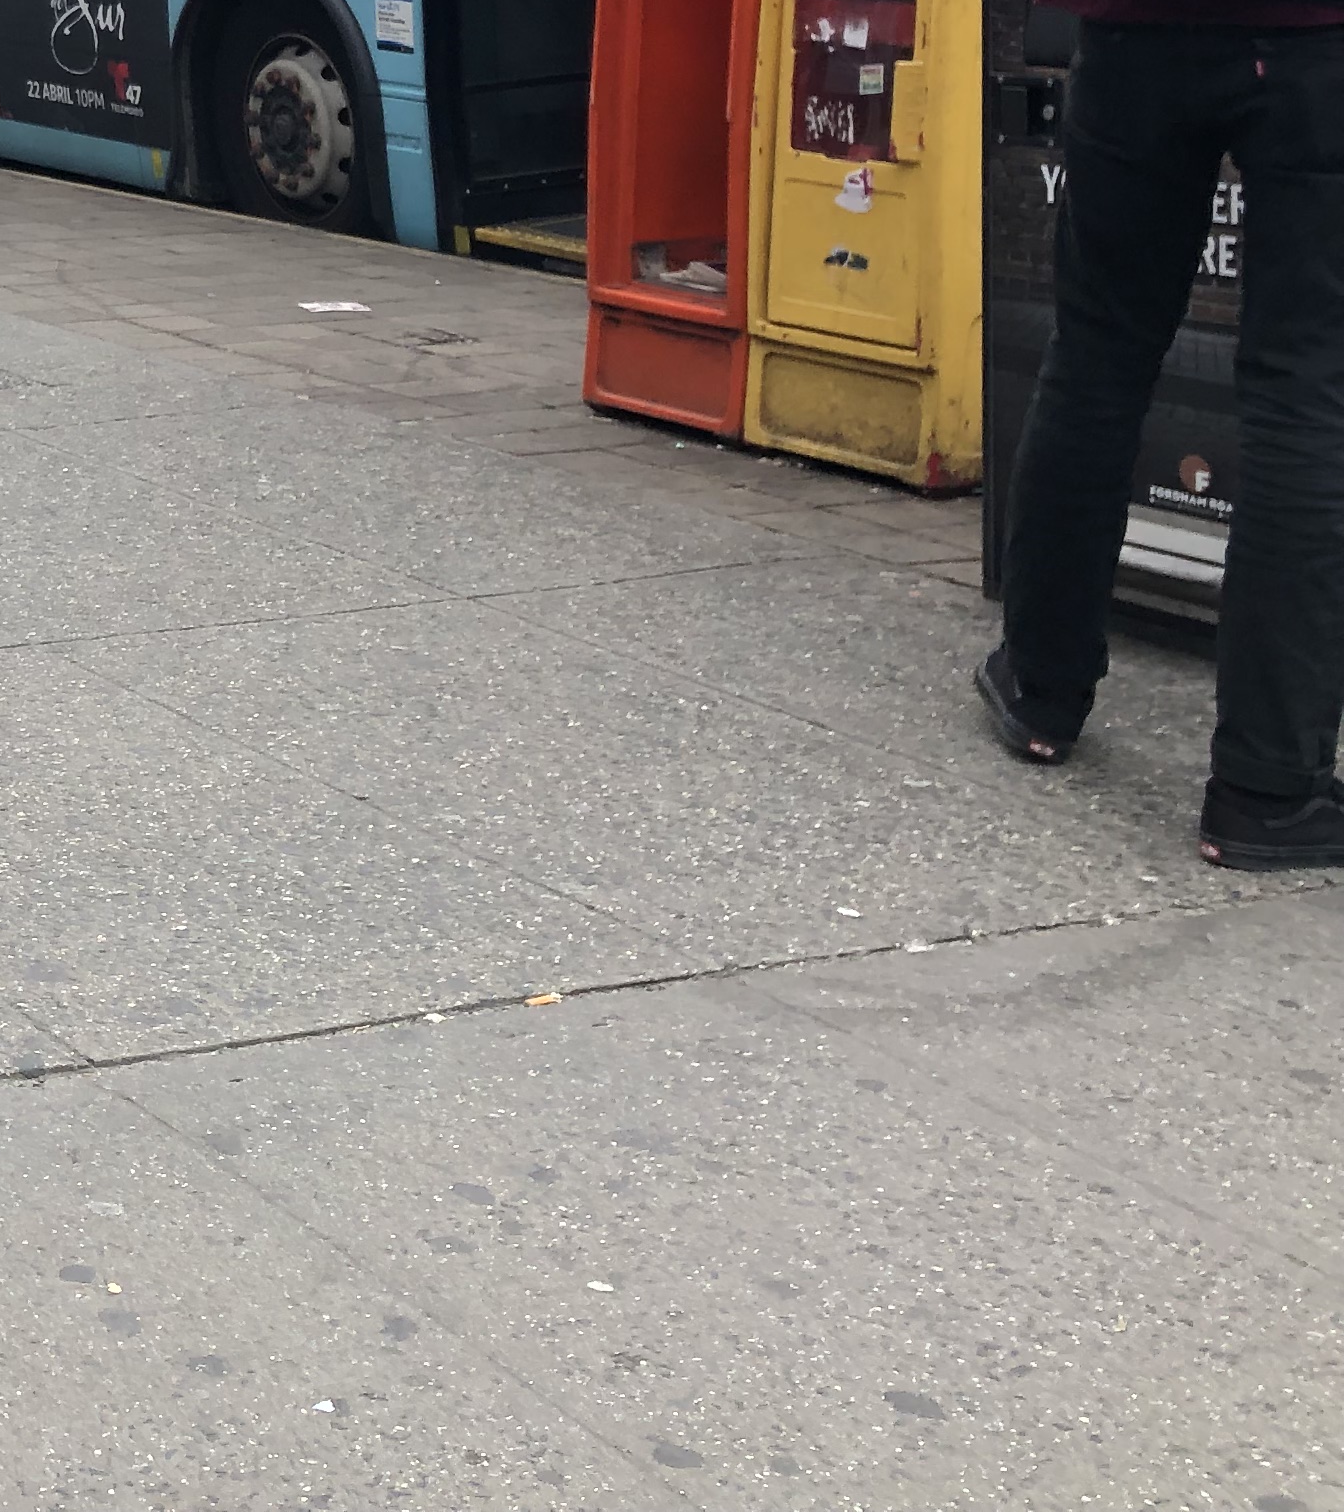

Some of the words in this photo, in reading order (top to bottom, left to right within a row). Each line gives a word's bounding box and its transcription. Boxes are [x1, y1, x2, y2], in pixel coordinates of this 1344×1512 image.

[26, 80, 41, 99] 22
[42, 82, 74, 105] ABRIL
[75, 88, 106, 110] 10PM
[125, 84, 142, 105] 47
[1209, 497, 1234, 514] ROA
